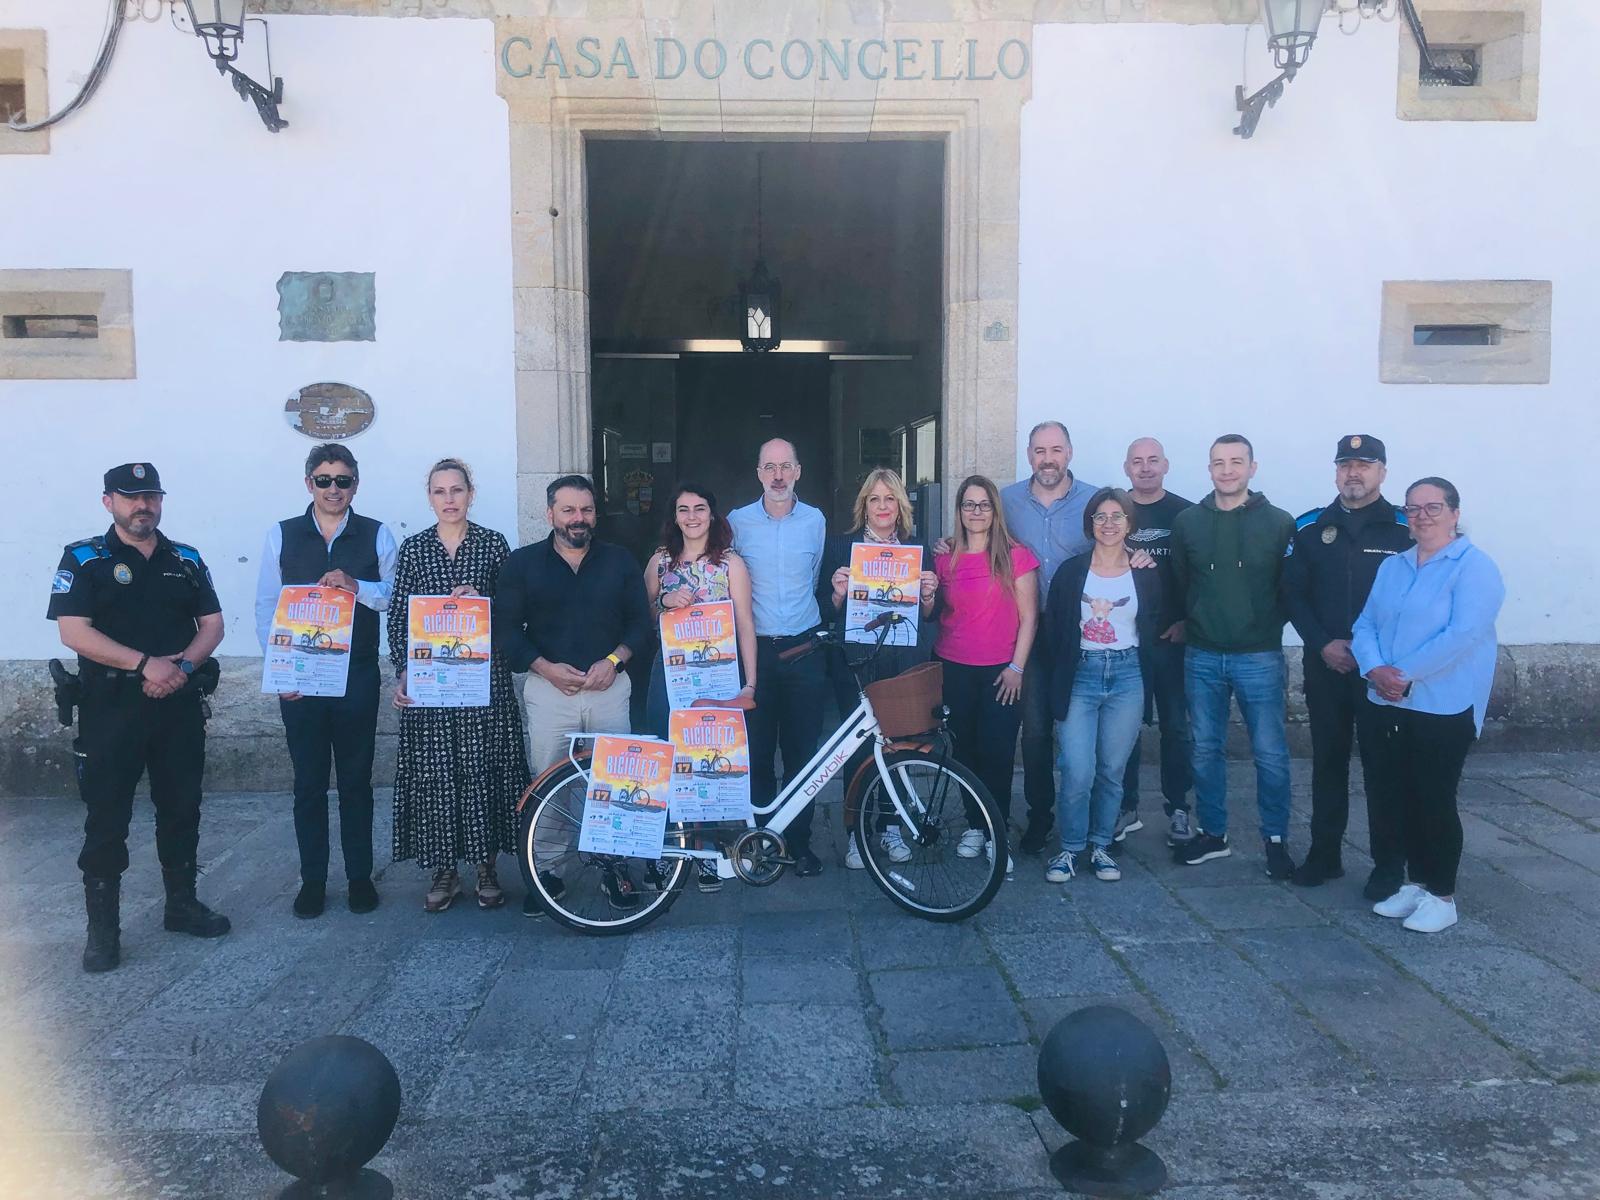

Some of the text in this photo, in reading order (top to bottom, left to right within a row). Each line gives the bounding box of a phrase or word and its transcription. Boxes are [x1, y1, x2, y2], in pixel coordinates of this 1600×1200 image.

[501, 36, 1031, 81] CASA DO CONCELLO
[1144, 547, 1171, 556] MARTI
[863, 560, 909, 578] BICICLETA
[855, 590, 867, 600] 17
[287, 602, 340, 624] BICICLETA
[423, 613, 477, 633] BICICLETA
[674, 619, 723, 640] BICICLETA
[276, 636, 291, 646] 17
[416, 649, 431, 659] 17
[671, 655, 684, 665] 17
[683, 726, 736, 746] BICICLETA
[606, 755, 660, 778] BICICLETA
[677, 763, 691, 773] 17
[594, 790, 609, 801] 17
